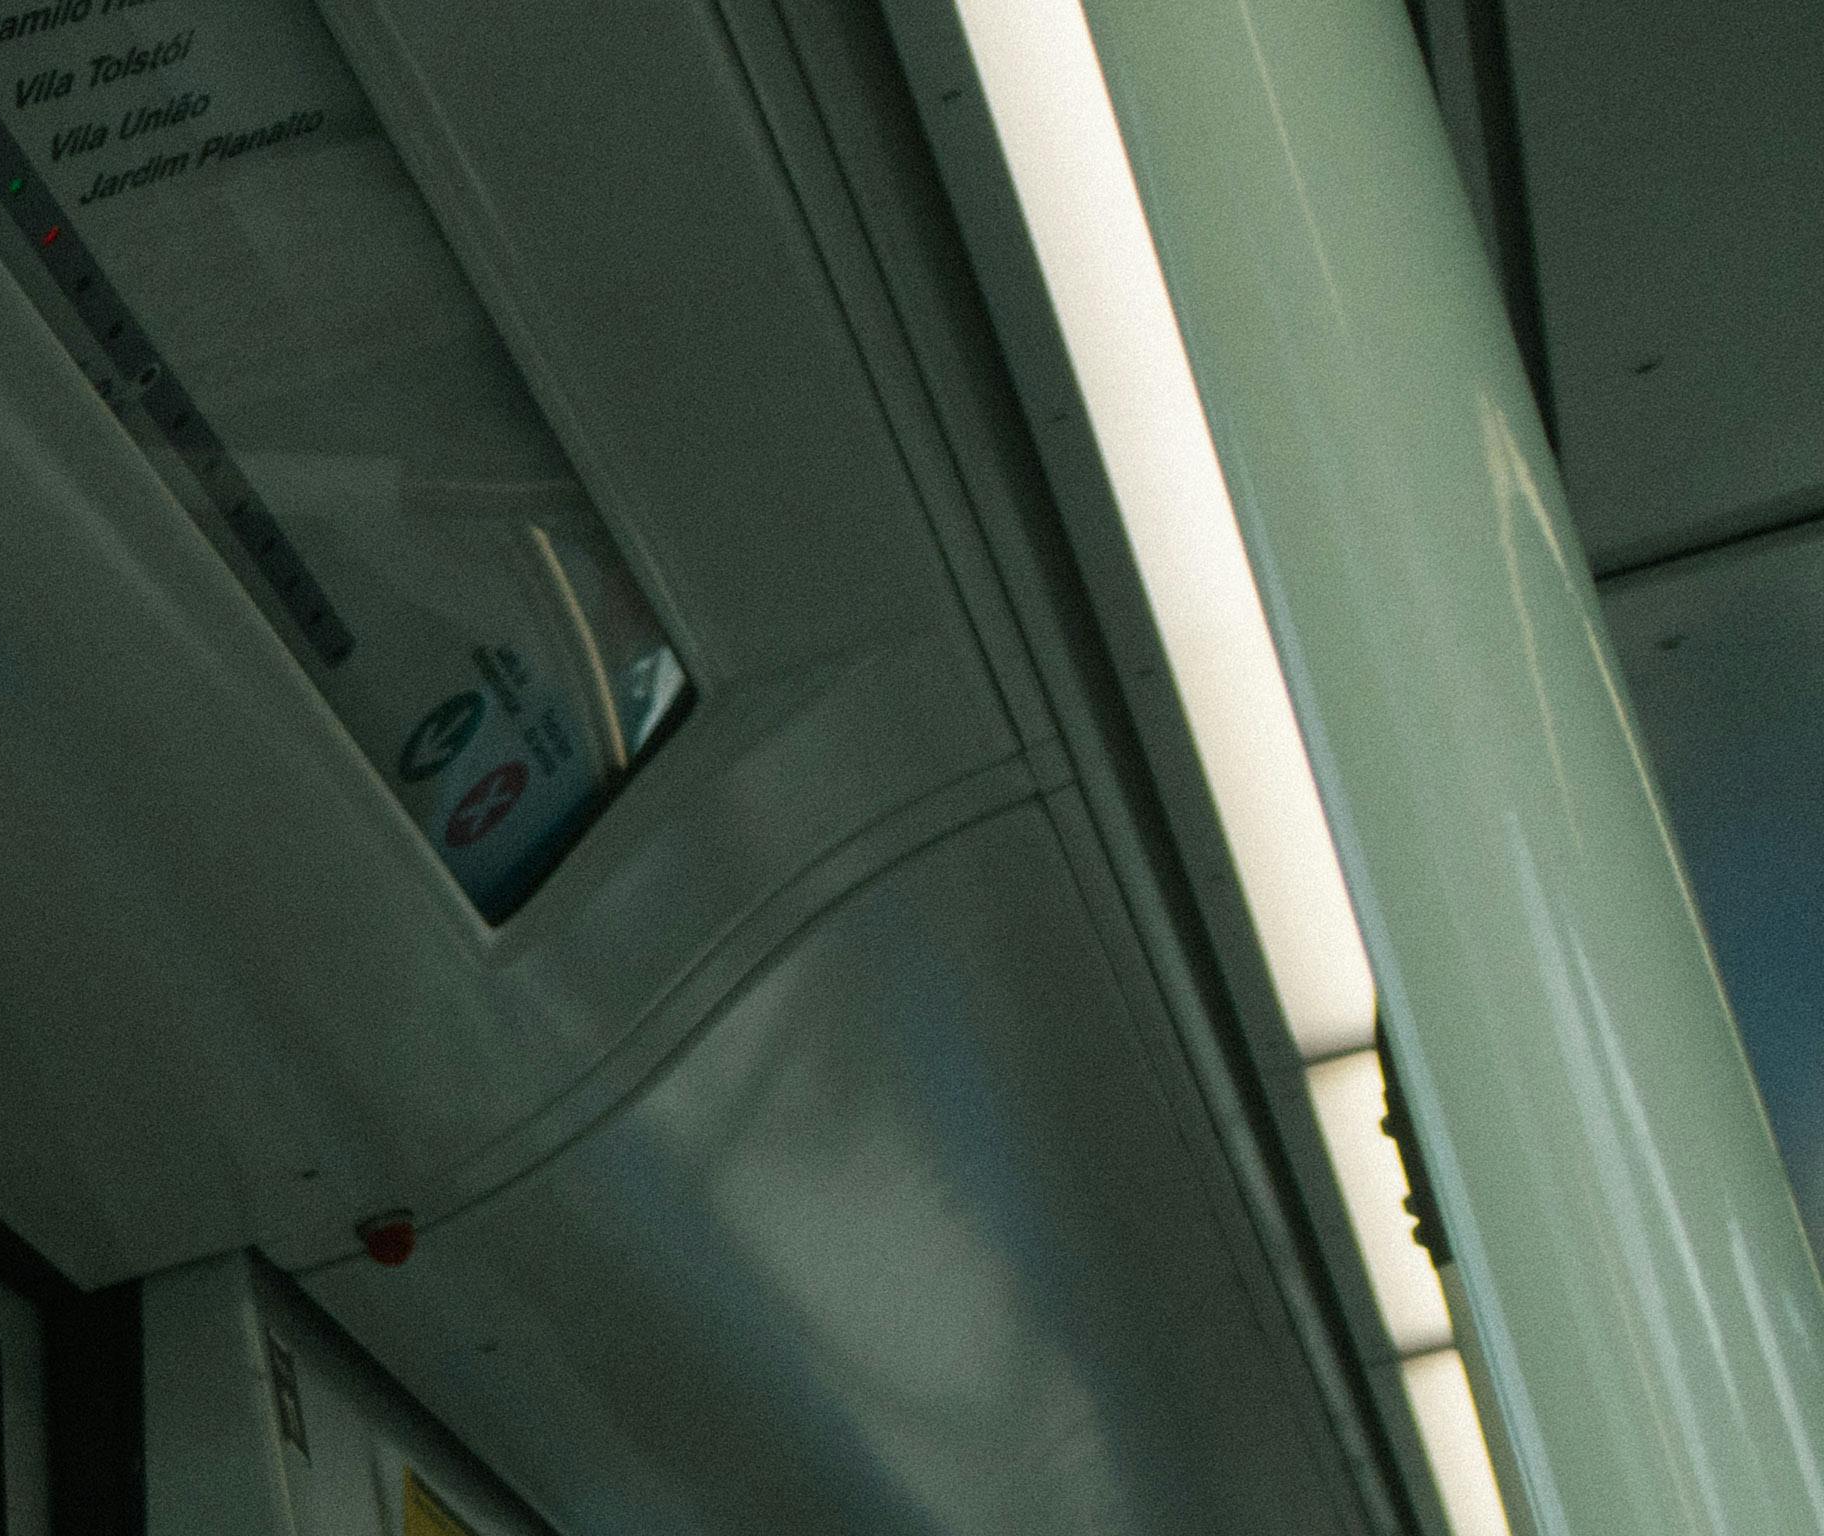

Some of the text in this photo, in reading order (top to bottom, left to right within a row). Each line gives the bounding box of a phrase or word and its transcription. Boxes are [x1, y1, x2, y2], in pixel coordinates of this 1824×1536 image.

[13, 29, 196, 110] Vila Tolstói
[50, 90, 211, 163] Vila União
[79, 109, 325, 205] Jardim Planalto
